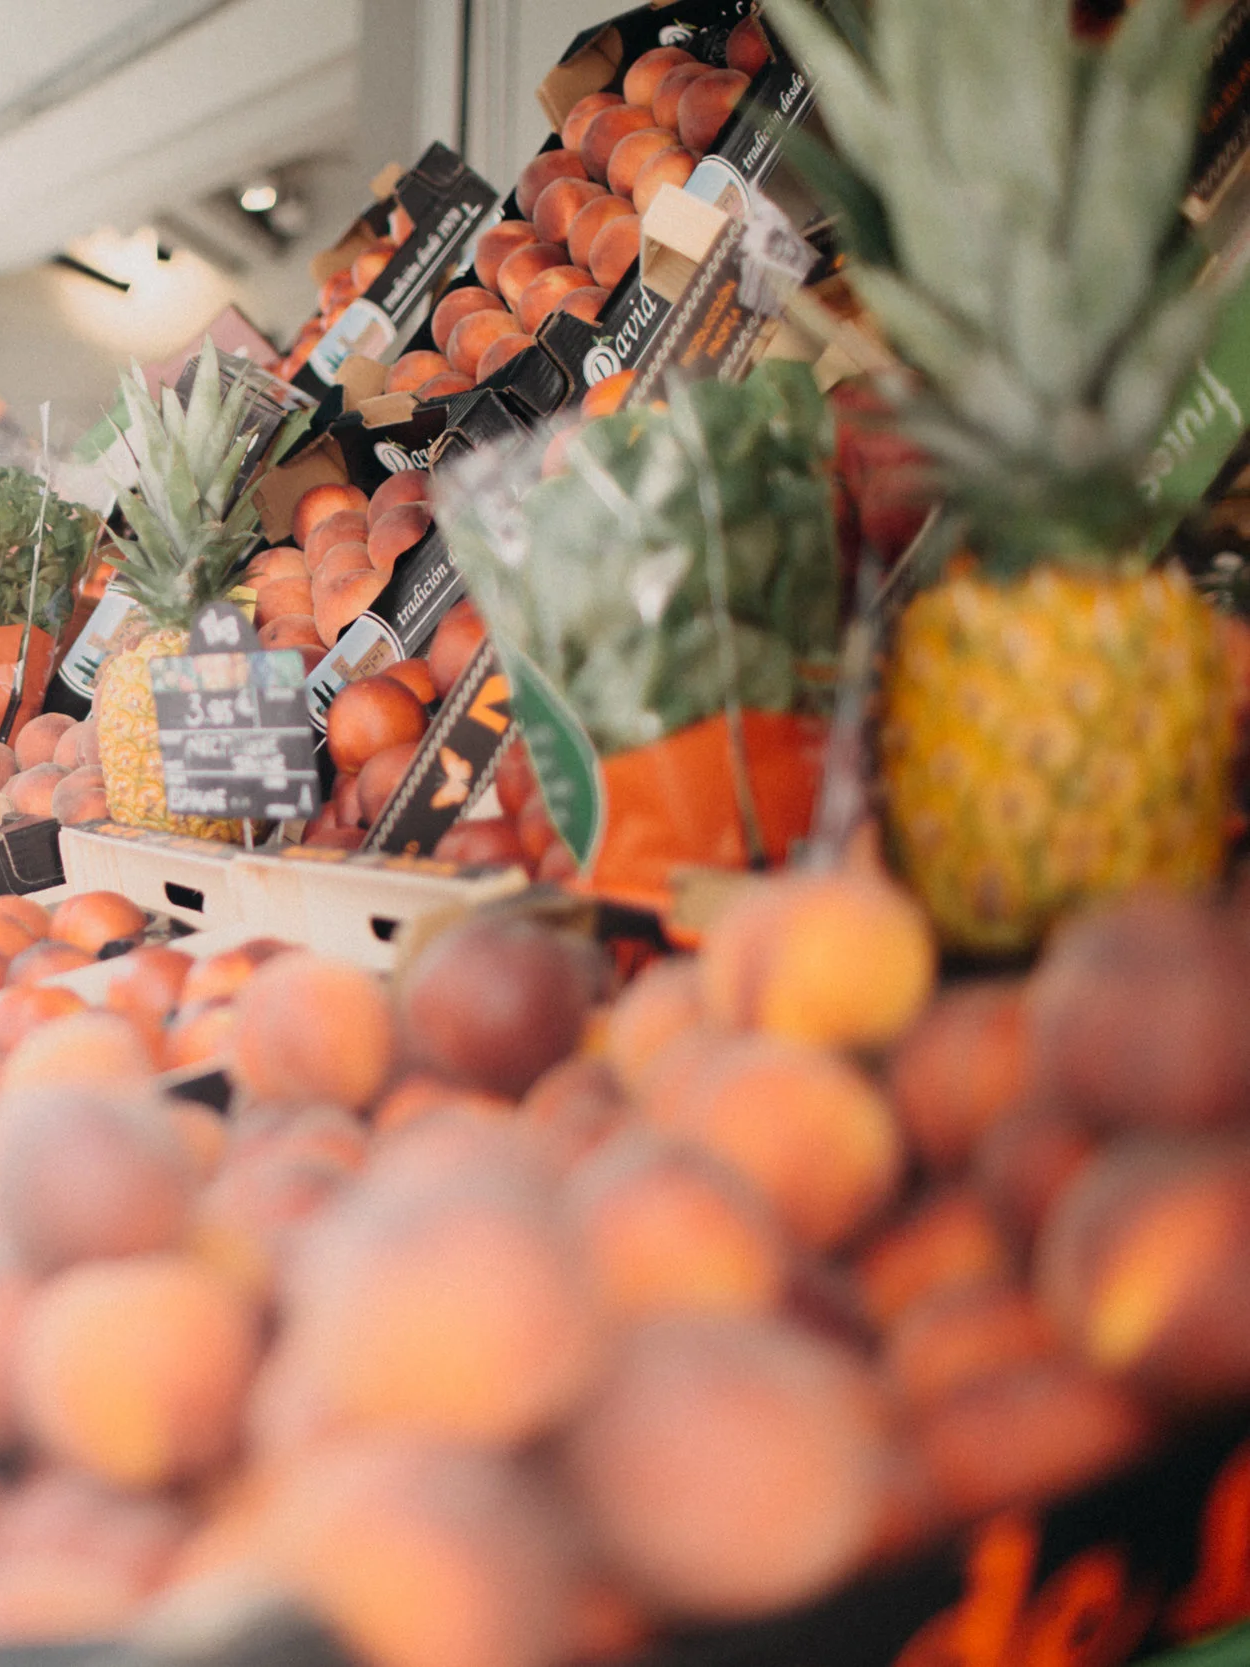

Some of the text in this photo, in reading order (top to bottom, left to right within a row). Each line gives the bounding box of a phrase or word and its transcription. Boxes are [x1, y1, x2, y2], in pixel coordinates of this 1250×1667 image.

[780, 73, 805, 112] desde
[583, 285, 657, 388] David
[397, 563, 449, 626] tradición
